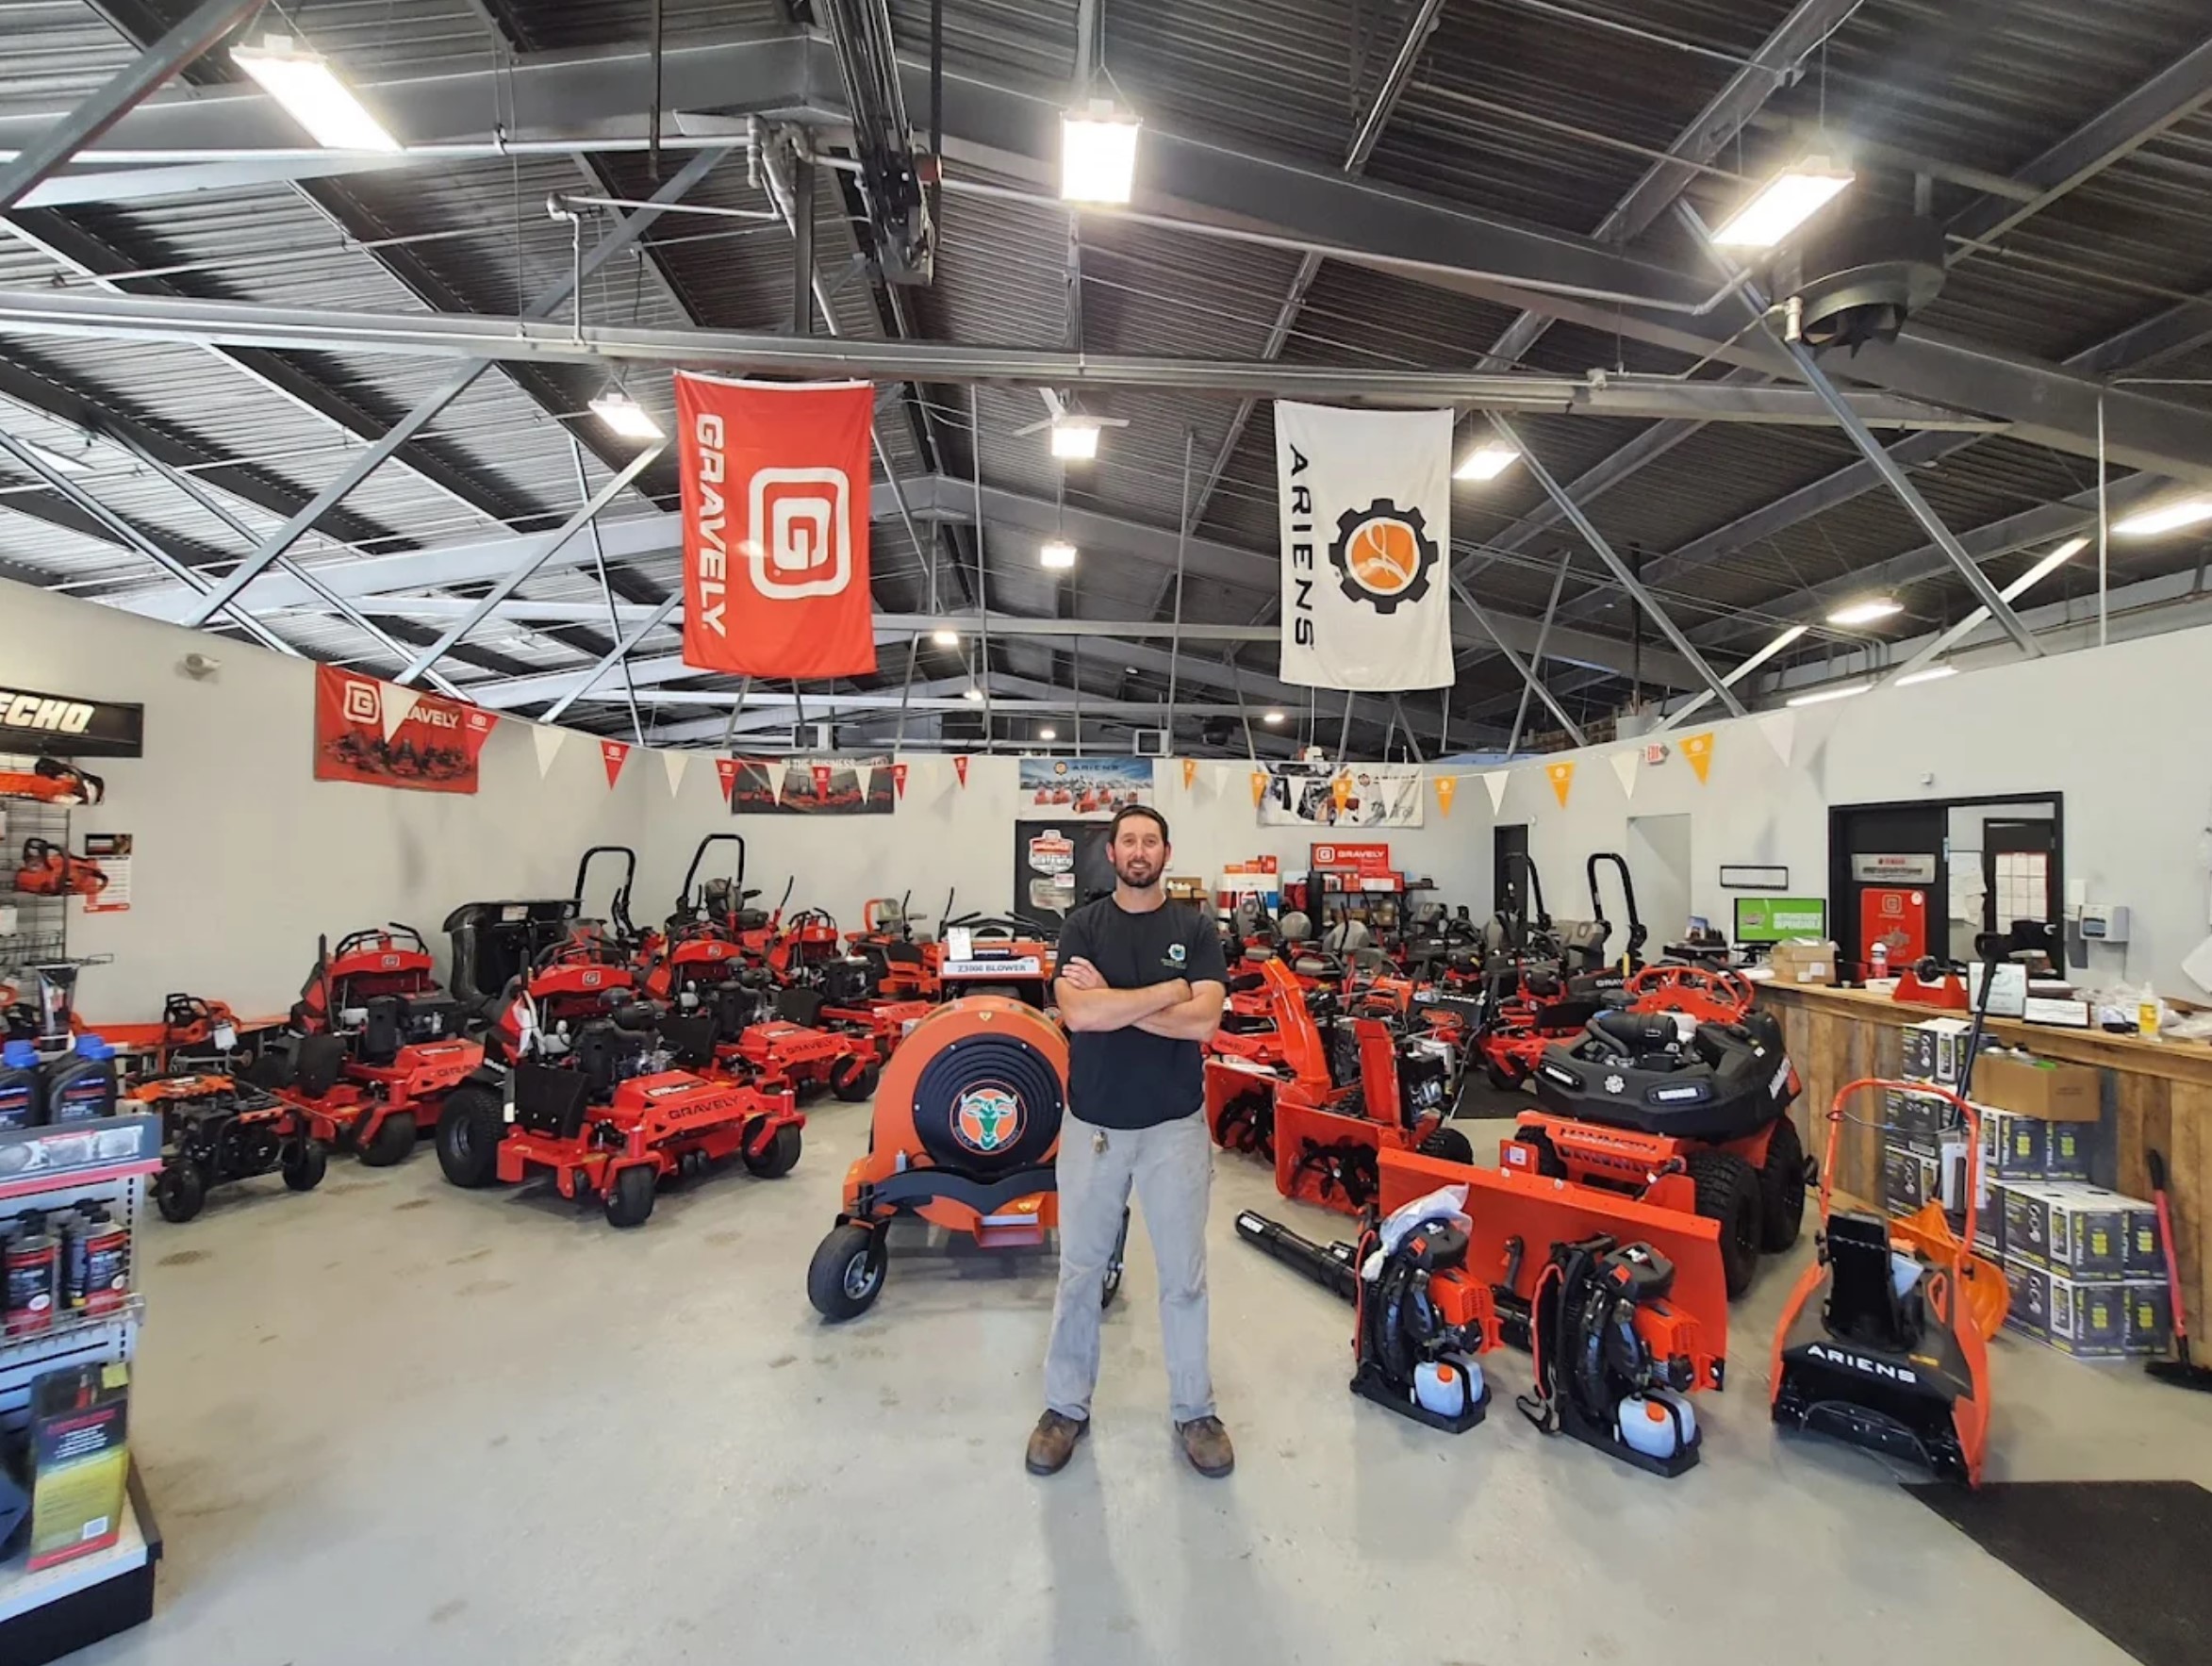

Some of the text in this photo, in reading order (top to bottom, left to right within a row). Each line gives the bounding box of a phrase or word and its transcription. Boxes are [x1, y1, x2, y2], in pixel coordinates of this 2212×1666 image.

[697, 412, 726, 638] GRAVELY
[1289, 442, 1314, 651] ARIENS
[407, 706, 460, 729] AVELY
[1595, 978, 1626, 988] GRAV
[668, 1095, 739, 1120] GRAVELY
[1807, 1344, 1917, 1384] ARIENS
